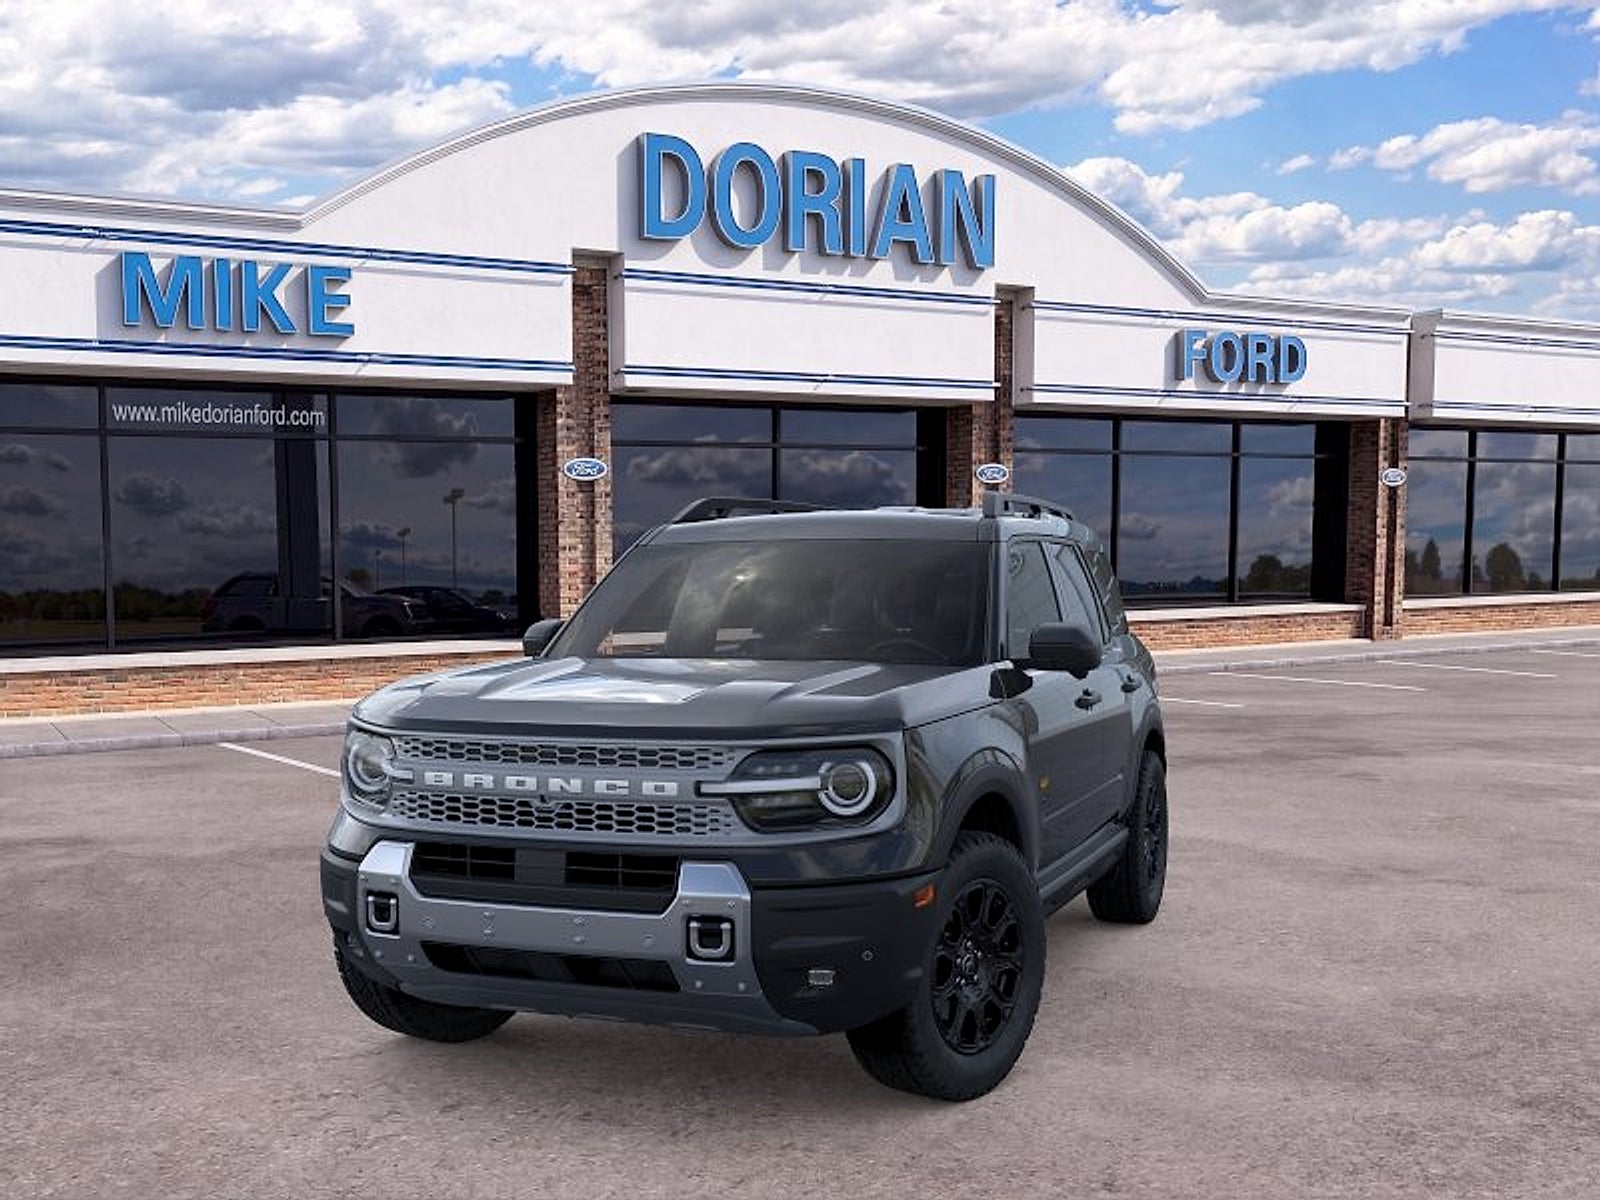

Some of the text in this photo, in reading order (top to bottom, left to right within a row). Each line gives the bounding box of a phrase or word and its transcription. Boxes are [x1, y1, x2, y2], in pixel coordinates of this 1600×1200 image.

[640, 132, 996, 269] DORIAN
[122, 252, 355, 337] MIKE
[1182, 328, 1307, 383] FORD
[112, 402, 325, 426] www.mikedorianford.com
[423, 771, 679, 796] BRONCO
